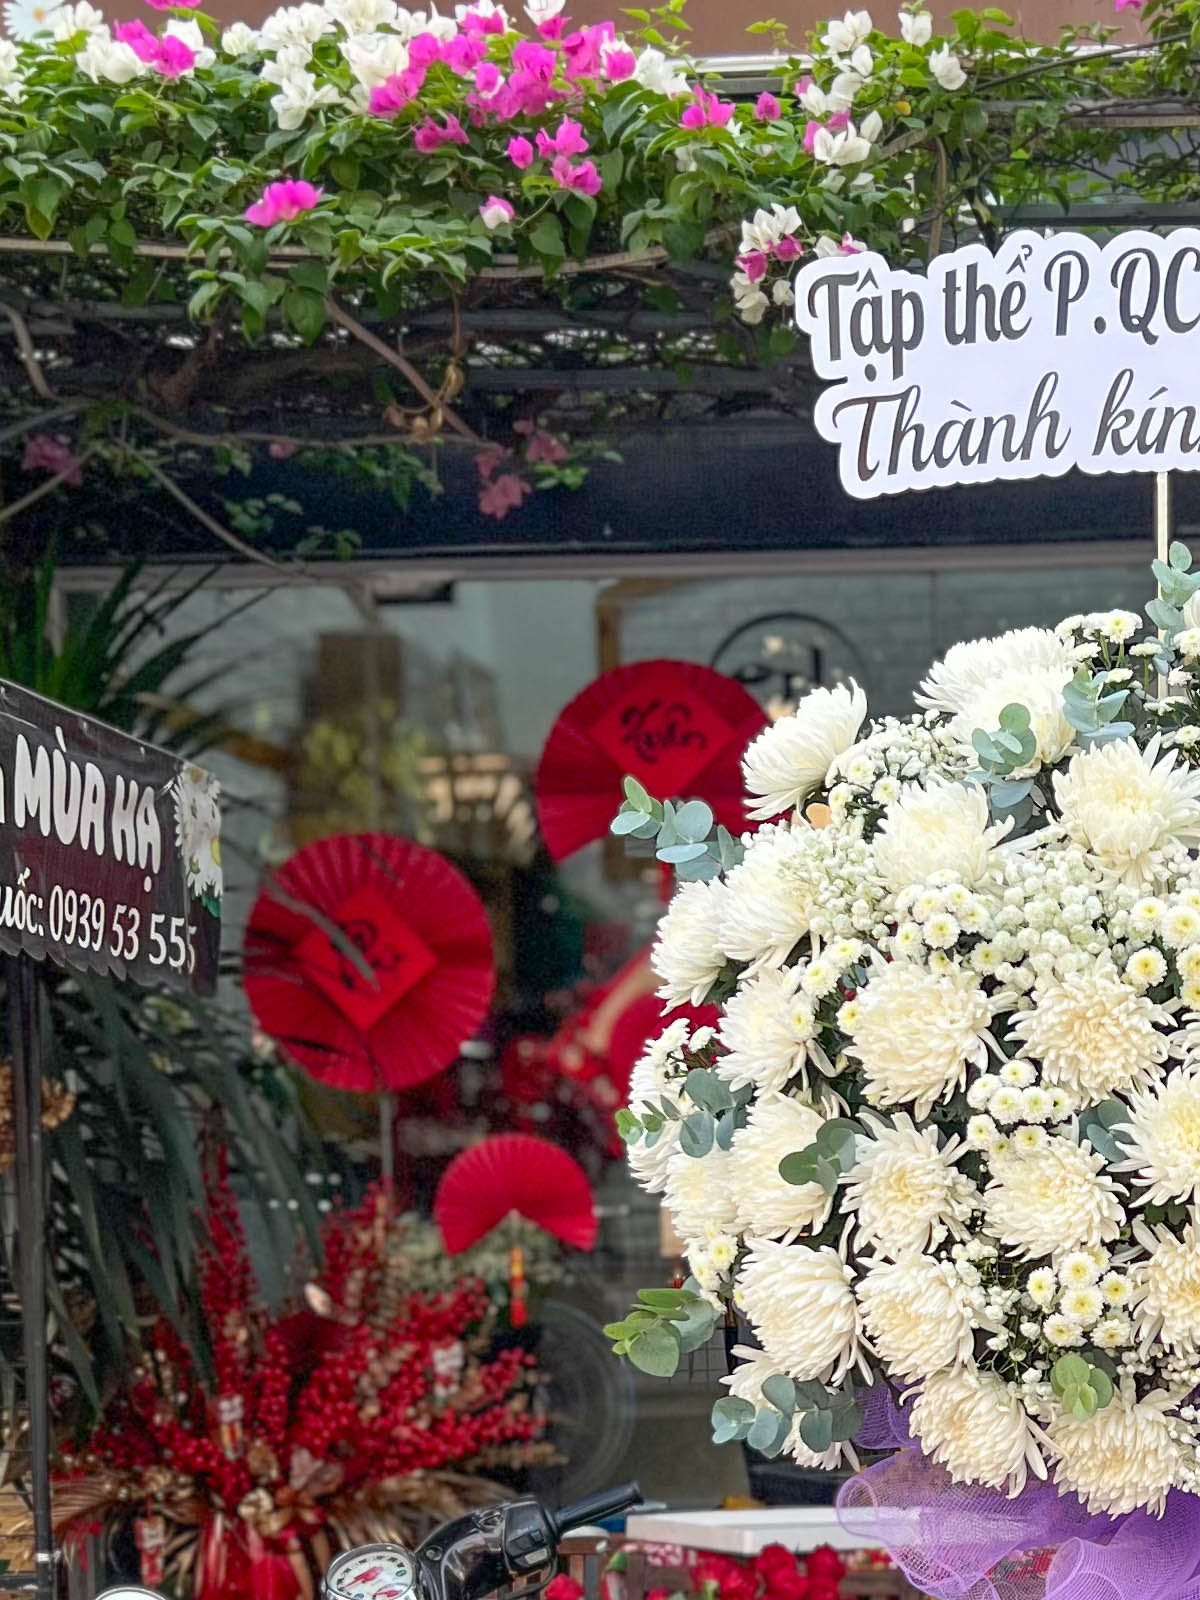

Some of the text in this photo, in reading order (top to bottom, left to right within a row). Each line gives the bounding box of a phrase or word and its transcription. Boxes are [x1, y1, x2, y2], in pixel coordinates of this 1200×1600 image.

[808, 267, 924, 382] Tập
[942, 244, 1033, 345] thể
[832, 372, 1071, 481] Thành
[14, 726, 105, 856] MÙA
[111, 775, 161, 893] HẠ
[50, 885, 105, 952] 0939
[111, 904, 141, 961] 53
